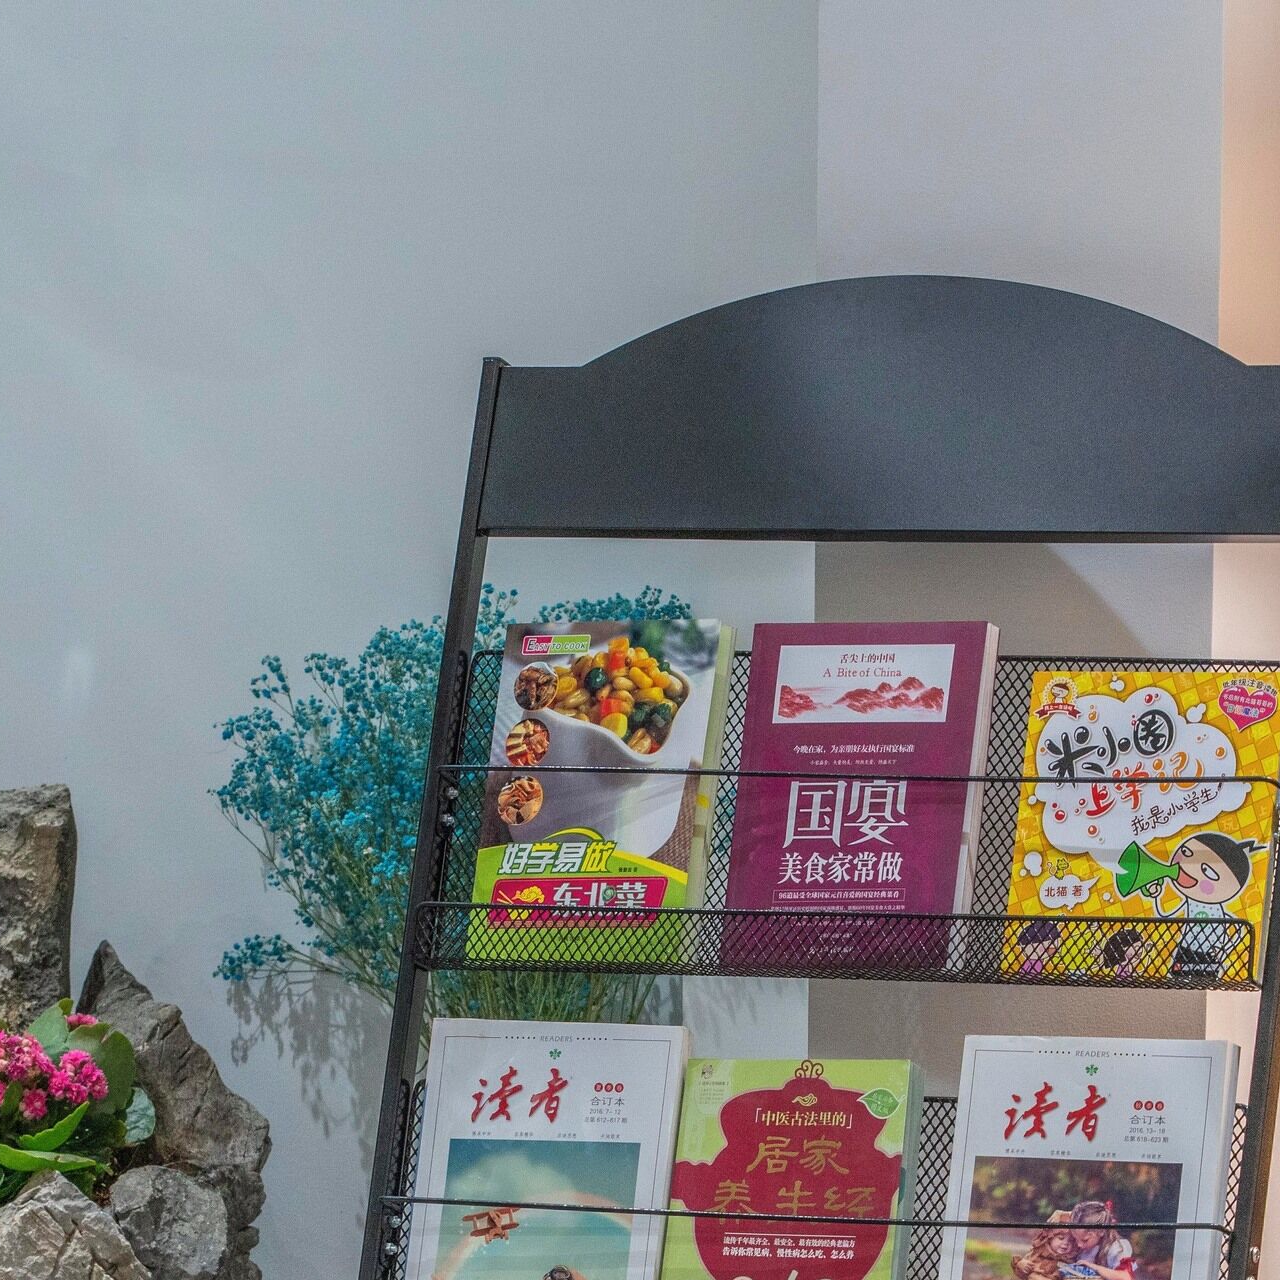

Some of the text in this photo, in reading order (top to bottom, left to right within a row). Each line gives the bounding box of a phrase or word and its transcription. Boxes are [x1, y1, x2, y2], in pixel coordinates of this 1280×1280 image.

[564, 641, 588, 650] COOK
[839, 653, 896, 664] 舌尖上的中国
[823, 667, 902, 678] A Bite of China
[1043, 709, 1174, 788] 米小圈
[1085, 751, 1205, 817] 上学记
[782, 779, 909, 849] 国宴
[1131, 787, 1219, 836] 我是小学生
[498, 841, 617, 875] 好学易做
[777, 851, 905, 885] 美食家常做
[1044, 885, 1083, 897] 北猫 著
[540, 1035, 574, 1043] READERS
[1075, 1050, 1110, 1058] READERS
[471, 1066, 568, 1124] 读者
[590, 1096, 625, 1107] 合订本
[1004, 1081, 1107, 1142] 读者
[1129, 1114, 1166, 1125] 合订本
[746, 1135, 850, 1175] 居家
[708, 1179, 877, 1224] 养生经
